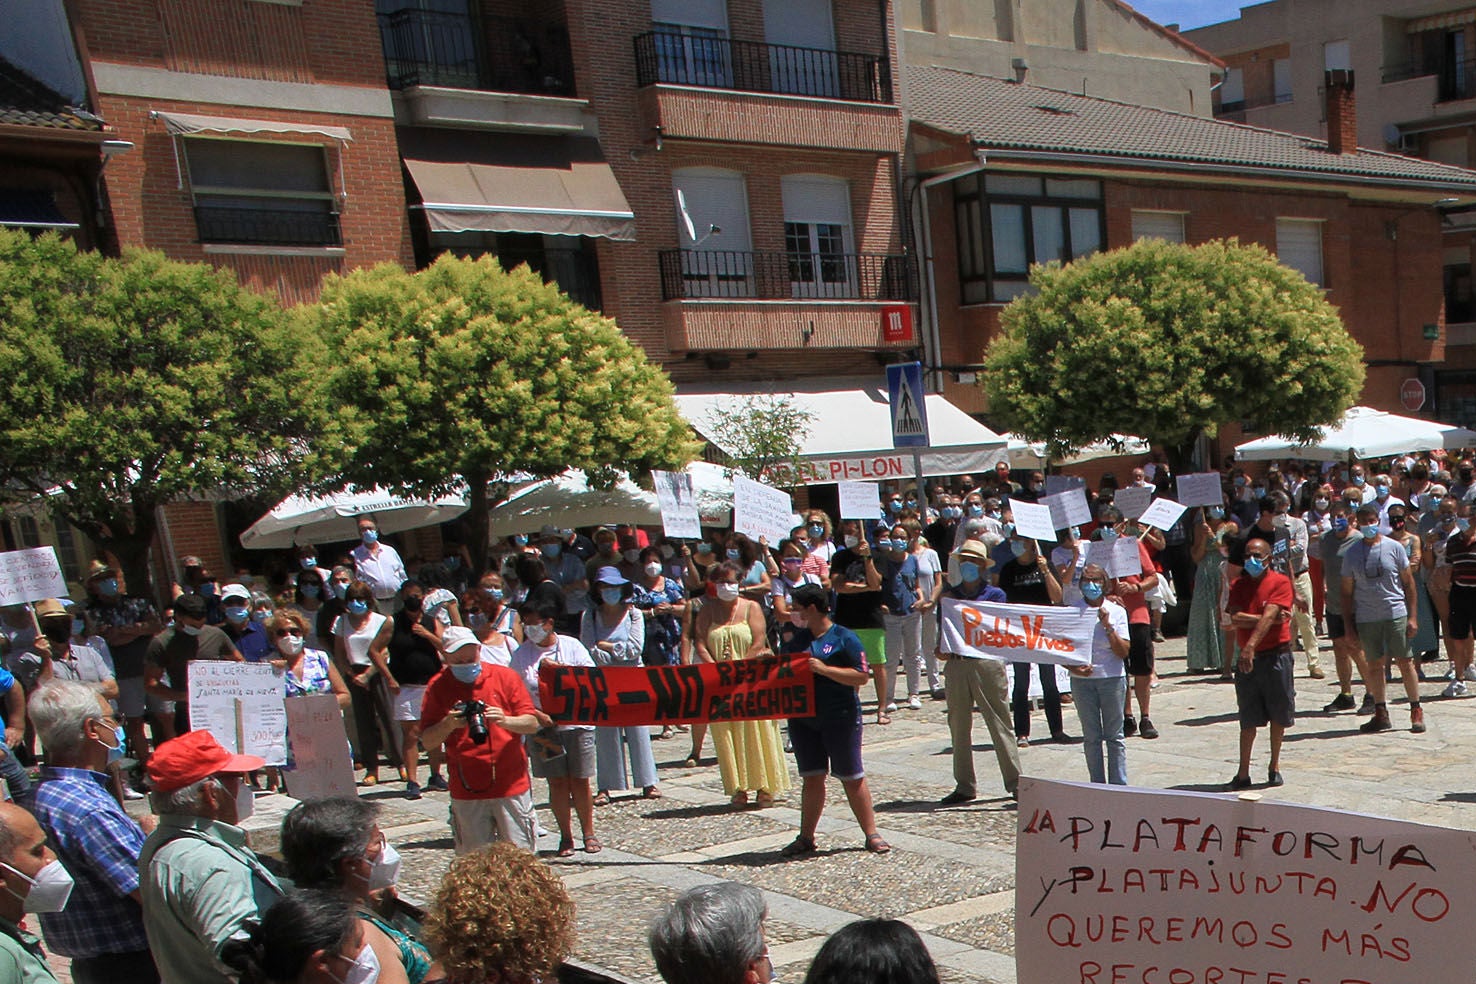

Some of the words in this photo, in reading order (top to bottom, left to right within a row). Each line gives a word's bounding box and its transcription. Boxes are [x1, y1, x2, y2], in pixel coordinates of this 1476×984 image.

[1403, 391, 1422, 399] STOP
[961, 607, 1025, 648] Pueblos
[1020, 615, 1075, 652] Vivos
[716, 655, 795, 687] RESTA
[708, 684, 809, 721] DERECHOS
[1023, 809, 1056, 834] LA
[1060, 816, 1437, 873] PLATAFORMA
[1360, 879, 1450, 922] NO
[1046, 912, 1294, 950] QUEREMOS
[1321, 924, 1412, 962] MÁS
